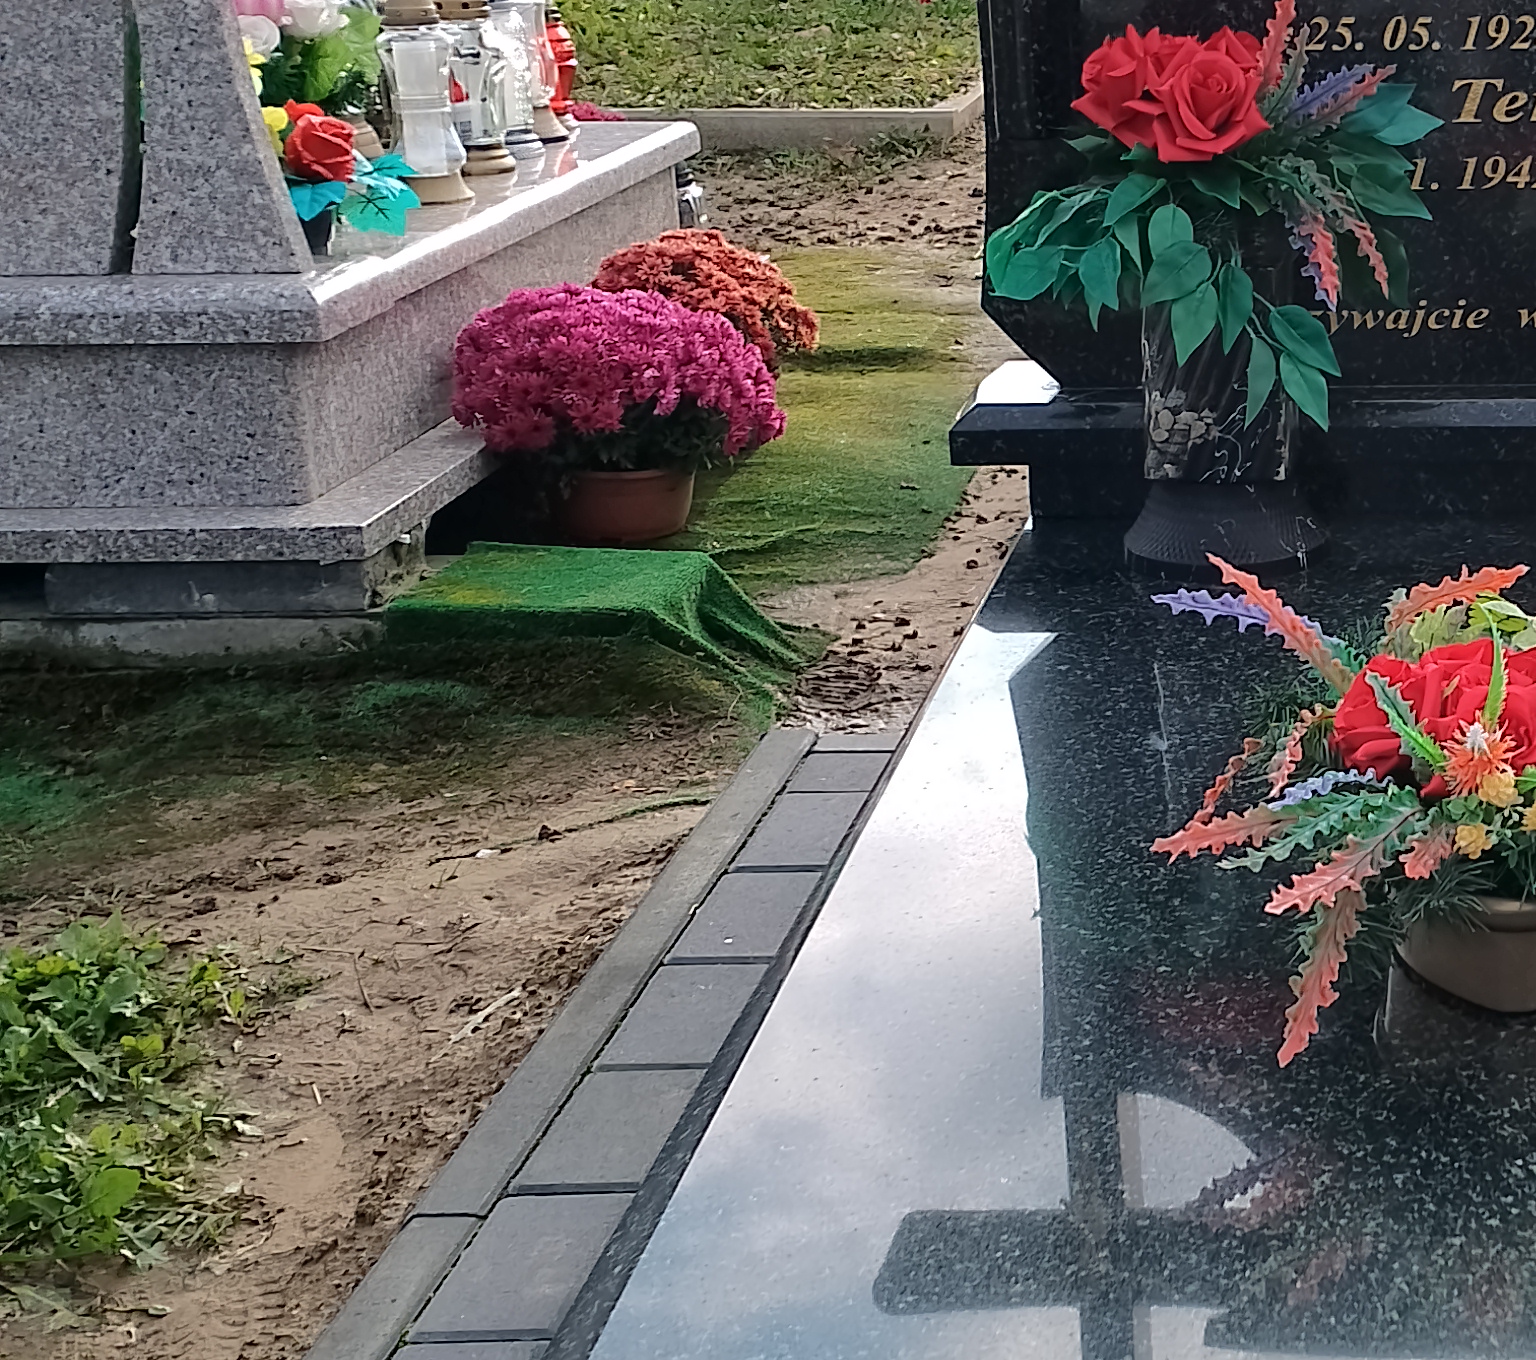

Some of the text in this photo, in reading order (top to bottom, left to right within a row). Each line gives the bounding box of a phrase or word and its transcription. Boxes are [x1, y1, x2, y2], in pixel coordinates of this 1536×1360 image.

[1383, 15, 1442, 51] 05.
[1410, 156, 1440, 190] 1.
[1308, 299, 1490, 338] ywajcie
